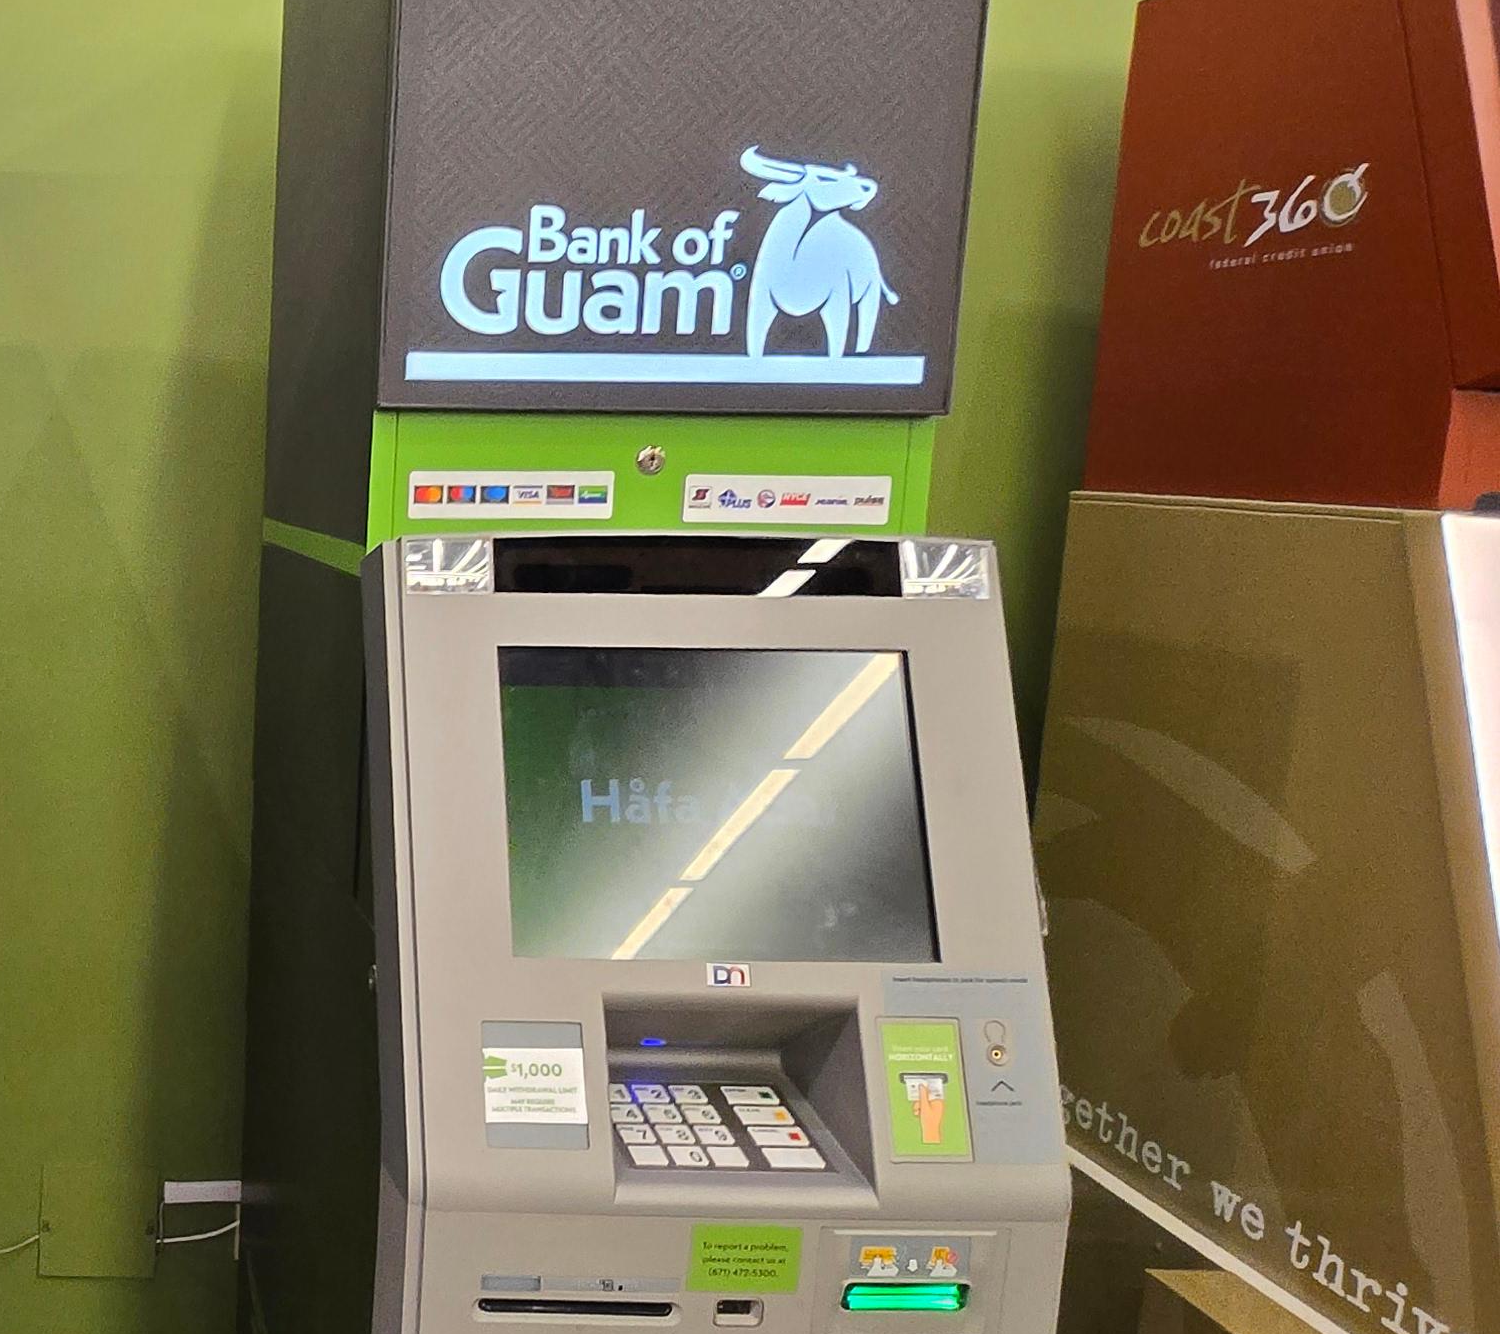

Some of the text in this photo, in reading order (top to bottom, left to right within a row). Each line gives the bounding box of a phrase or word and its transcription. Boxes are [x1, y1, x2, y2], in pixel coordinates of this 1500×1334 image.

[527, 204, 741, 266] Bank of
[510, 1063, 563, 1080] $1,000
[1211, 1180, 1265, 1241] we
